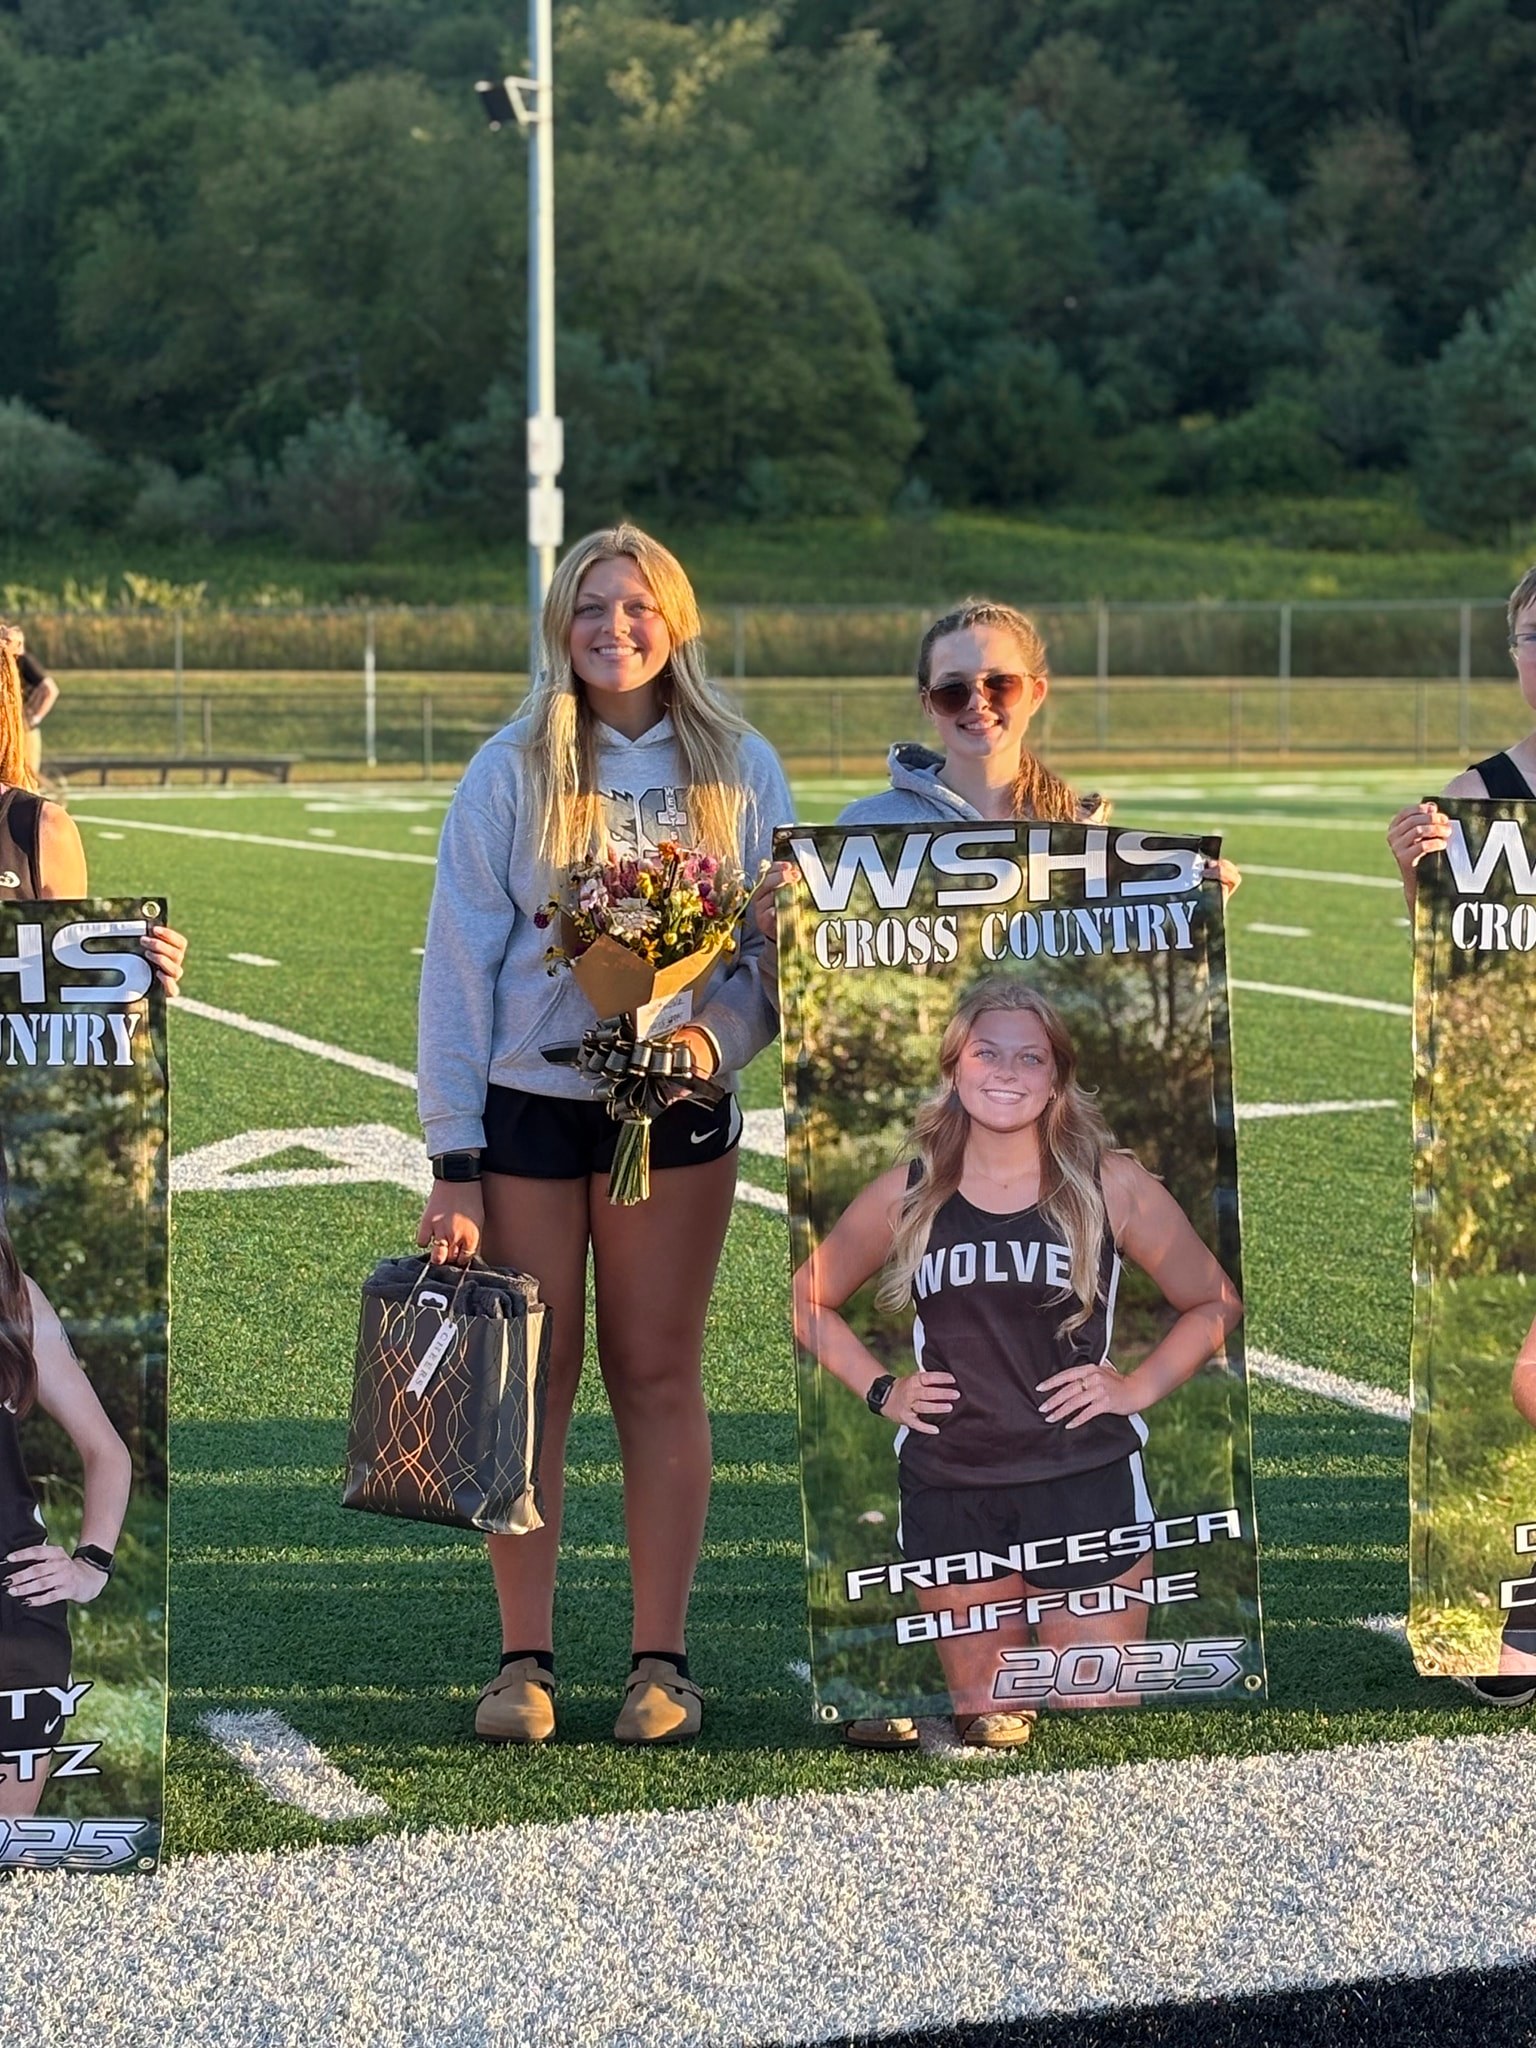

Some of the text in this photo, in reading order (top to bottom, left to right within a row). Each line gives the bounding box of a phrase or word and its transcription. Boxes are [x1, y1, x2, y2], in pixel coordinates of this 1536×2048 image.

[789, 828, 1204, 912] WSHS
[814, 900, 1198, 970] CROSS COUNTRY
[0, 1013, 142, 1067] NTRY
[914, 1240, 1100, 1300] WOLVE
[415, 1332, 449, 1386] CHEERS
[846, 1508, 1241, 1601] FRANCESCA
[895, 1570, 1200, 1645] BUFFONE
[992, 1638, 1246, 1700] 2025
[0, 1741, 103, 1782] TZ
[0, 1819, 147, 1865] 25
